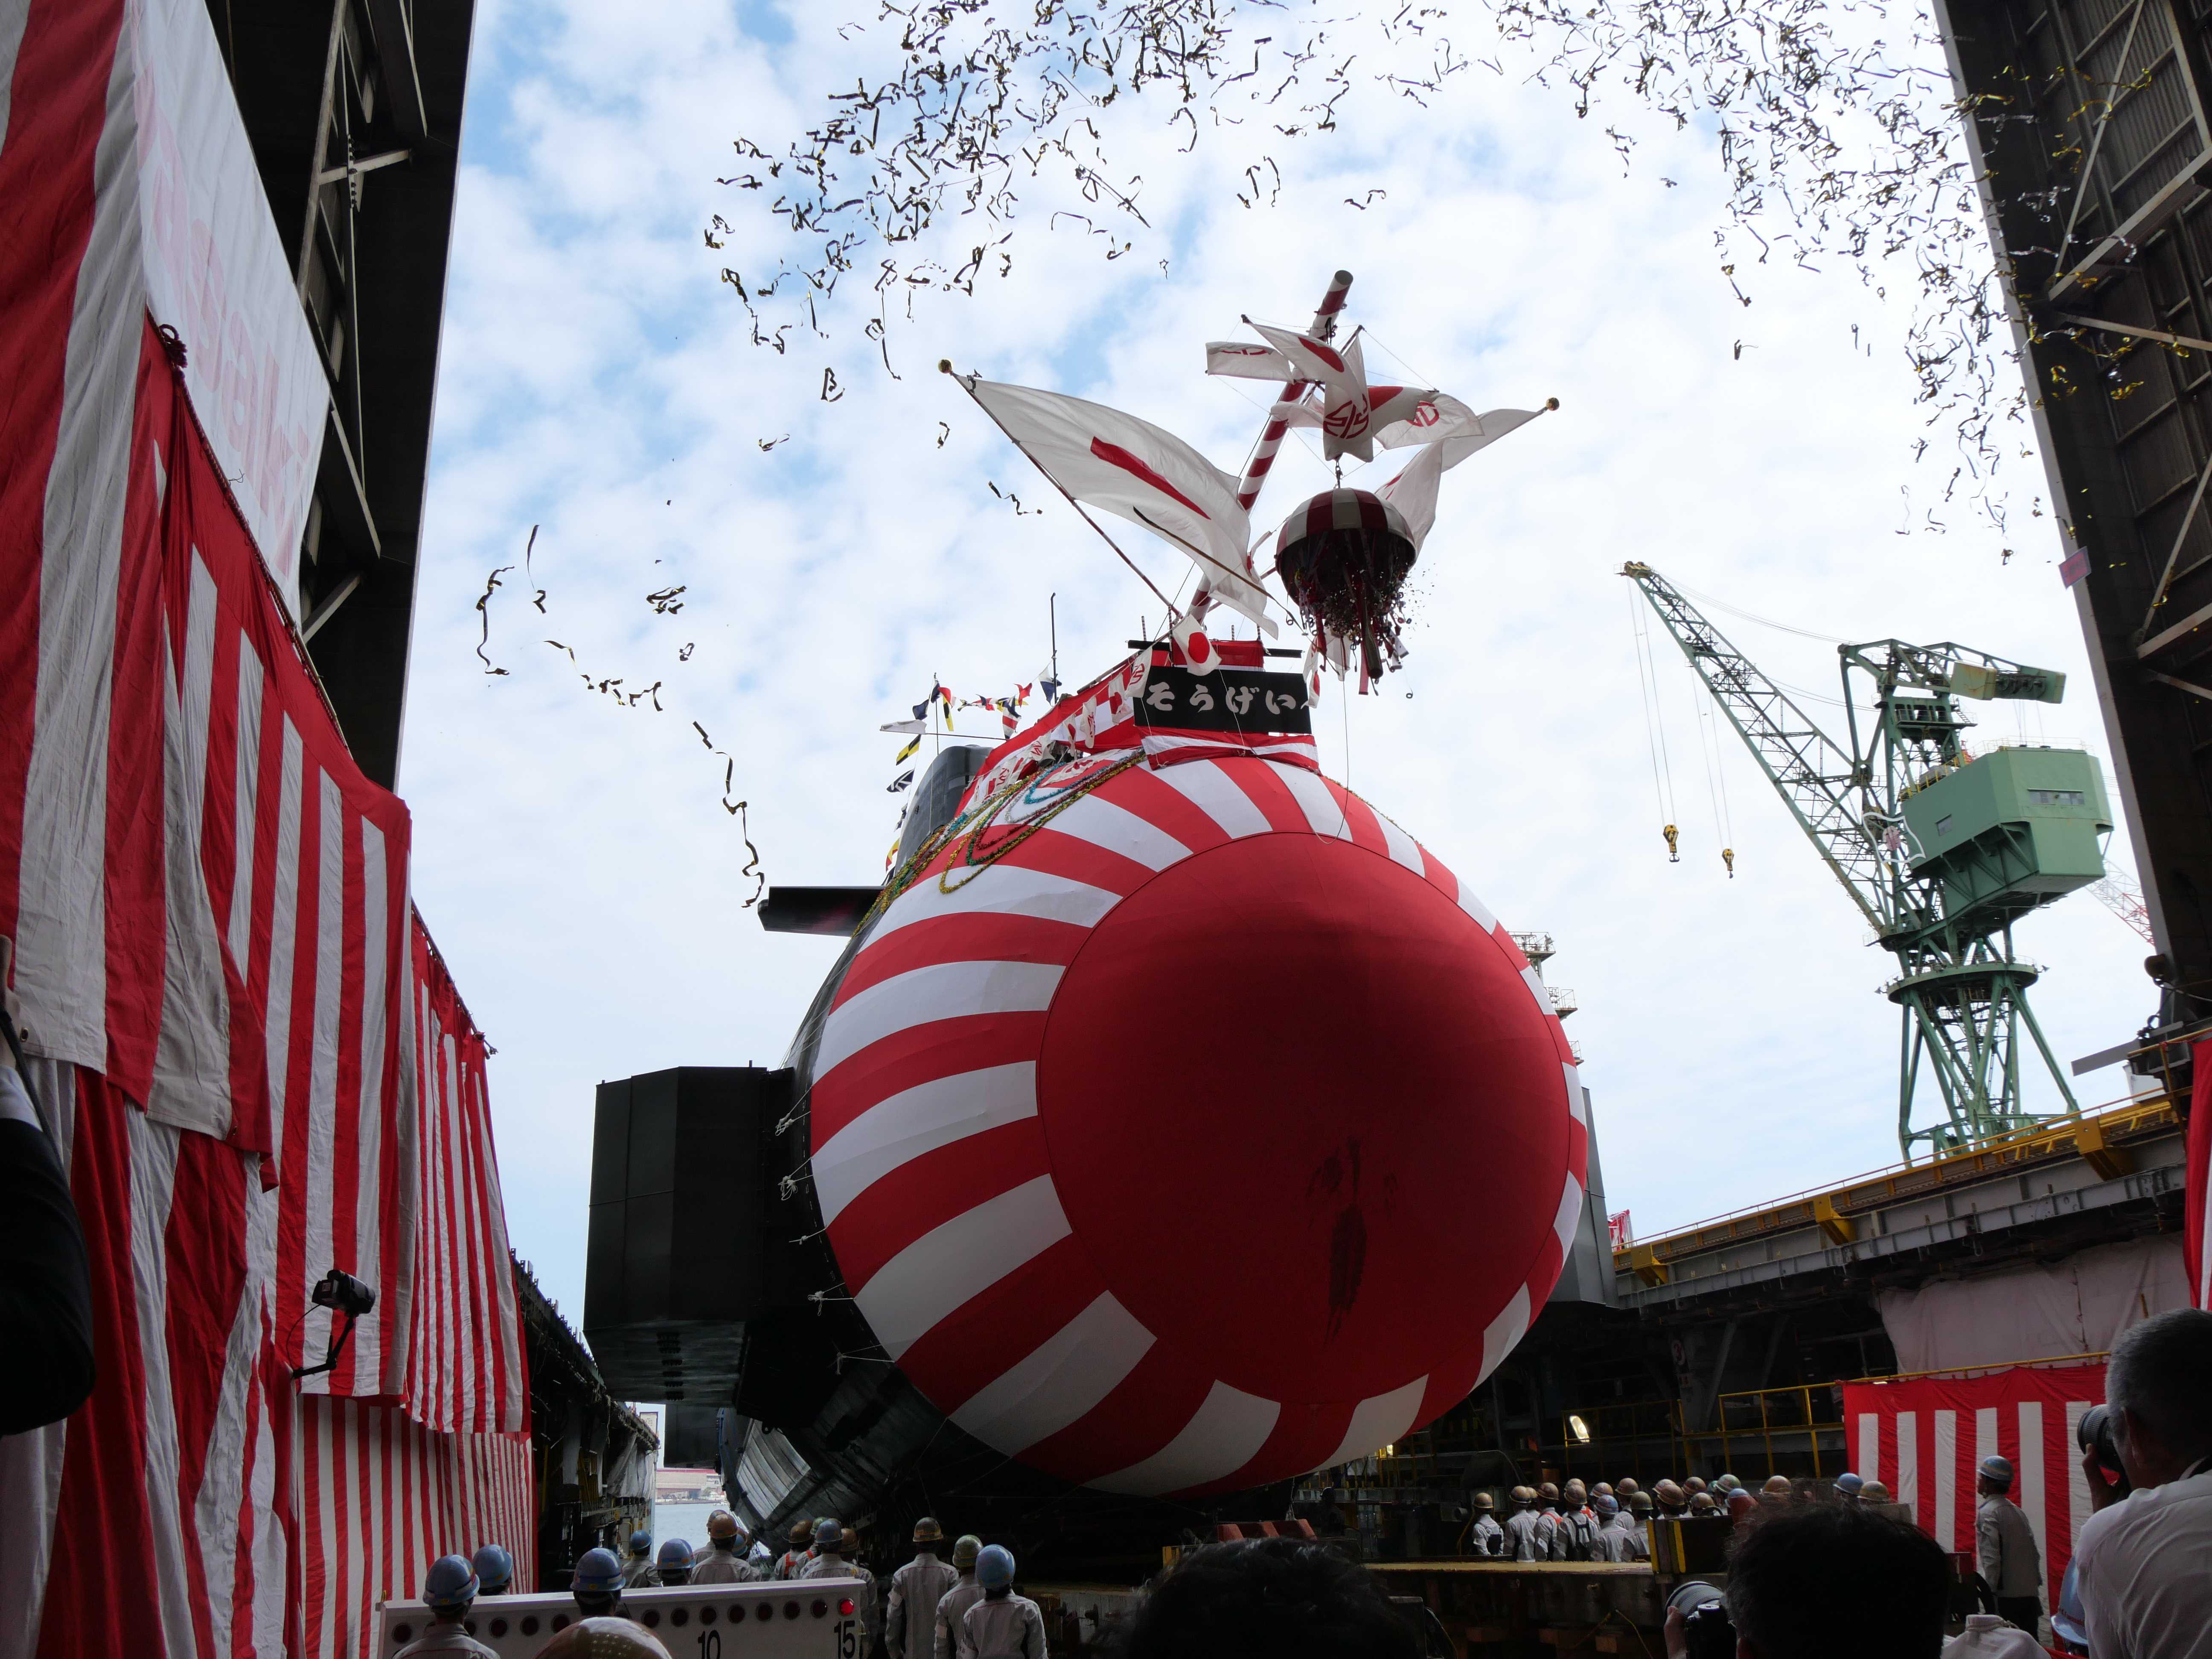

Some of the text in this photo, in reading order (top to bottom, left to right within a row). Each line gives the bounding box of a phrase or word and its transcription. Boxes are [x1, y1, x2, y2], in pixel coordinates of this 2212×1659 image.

[1147, 681, 1296, 715] そうげい
[698, 1630, 721, 1659] 10
[834, 1620, 856, 1659] 15
